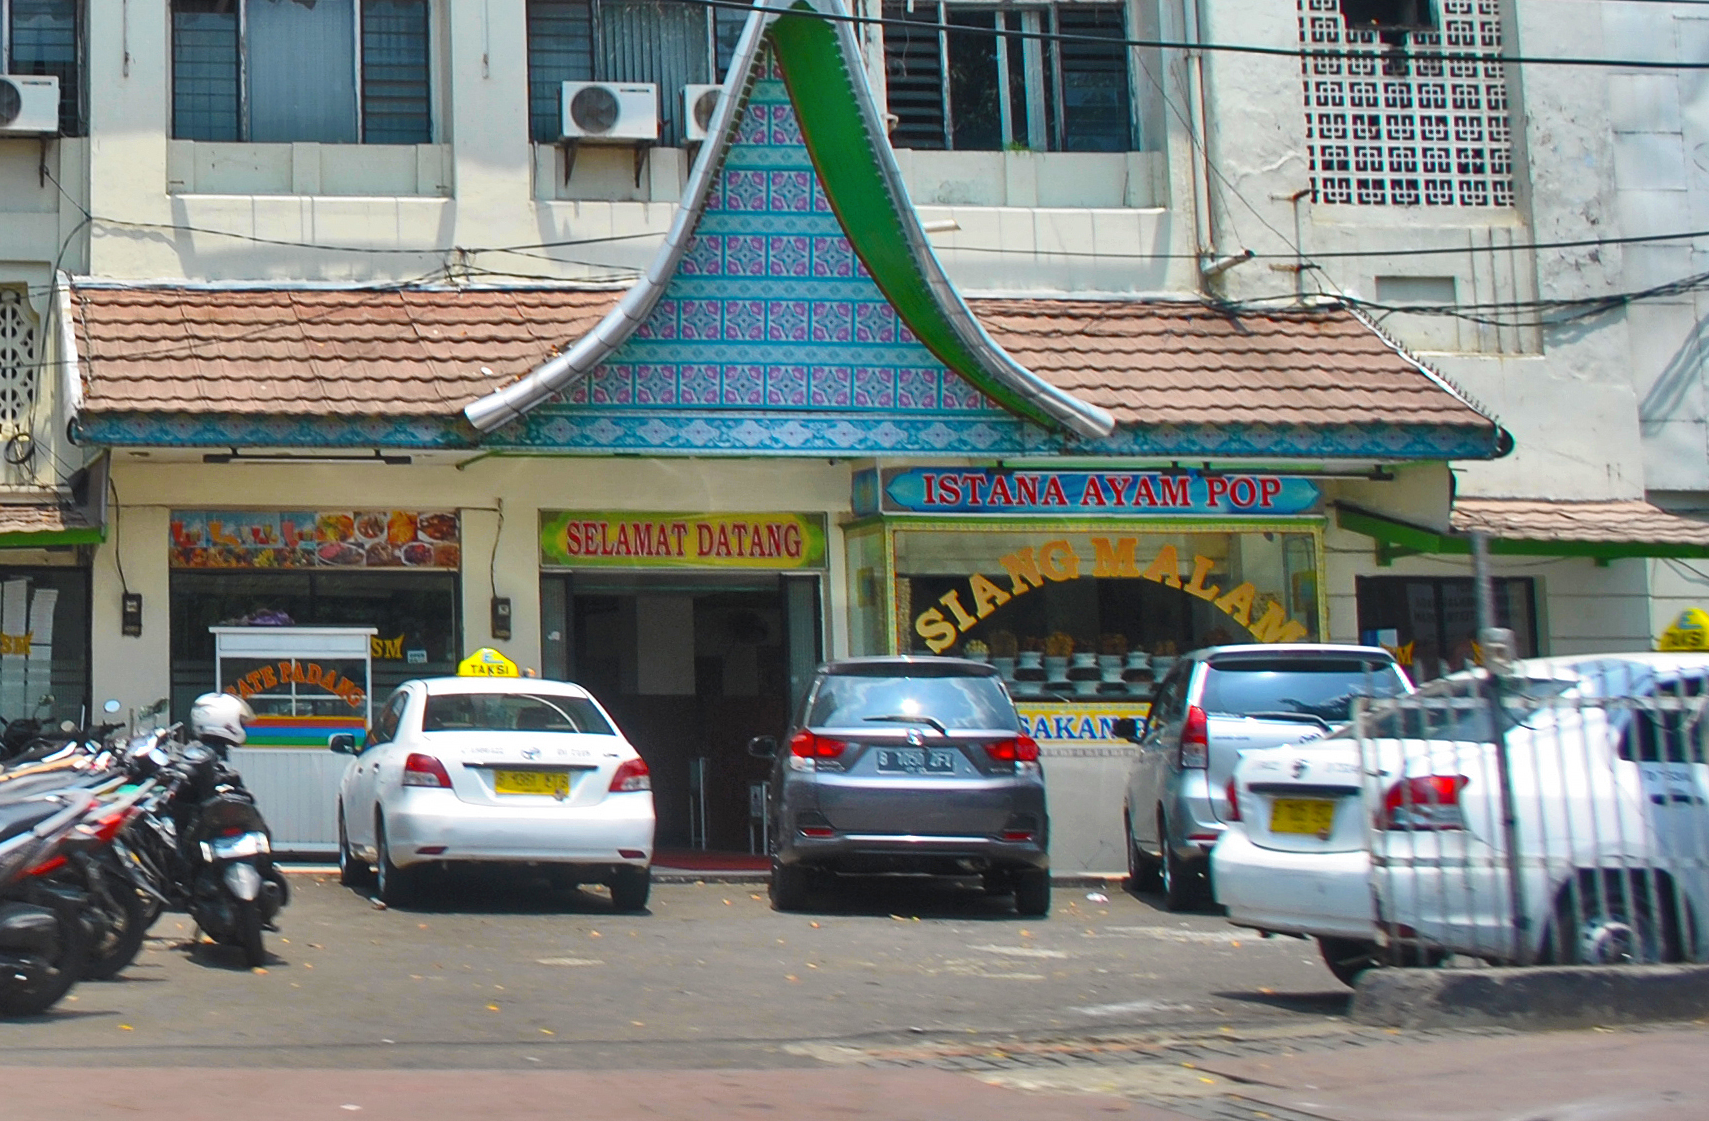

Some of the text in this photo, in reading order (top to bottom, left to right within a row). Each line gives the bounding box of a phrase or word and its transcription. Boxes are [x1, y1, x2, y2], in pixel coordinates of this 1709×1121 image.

[922, 474, 1283, 508] ISTANA AYAM POP
[566, 519, 803, 559] SELAMAT DATANG
[915, 540, 1081, 654] SIANG
[1091, 537, 1308, 644] MALAM
[371, 633, 405, 659] SM
[278, 661, 365, 708] PADANG
[470, 664, 509, 675] TAKSI
